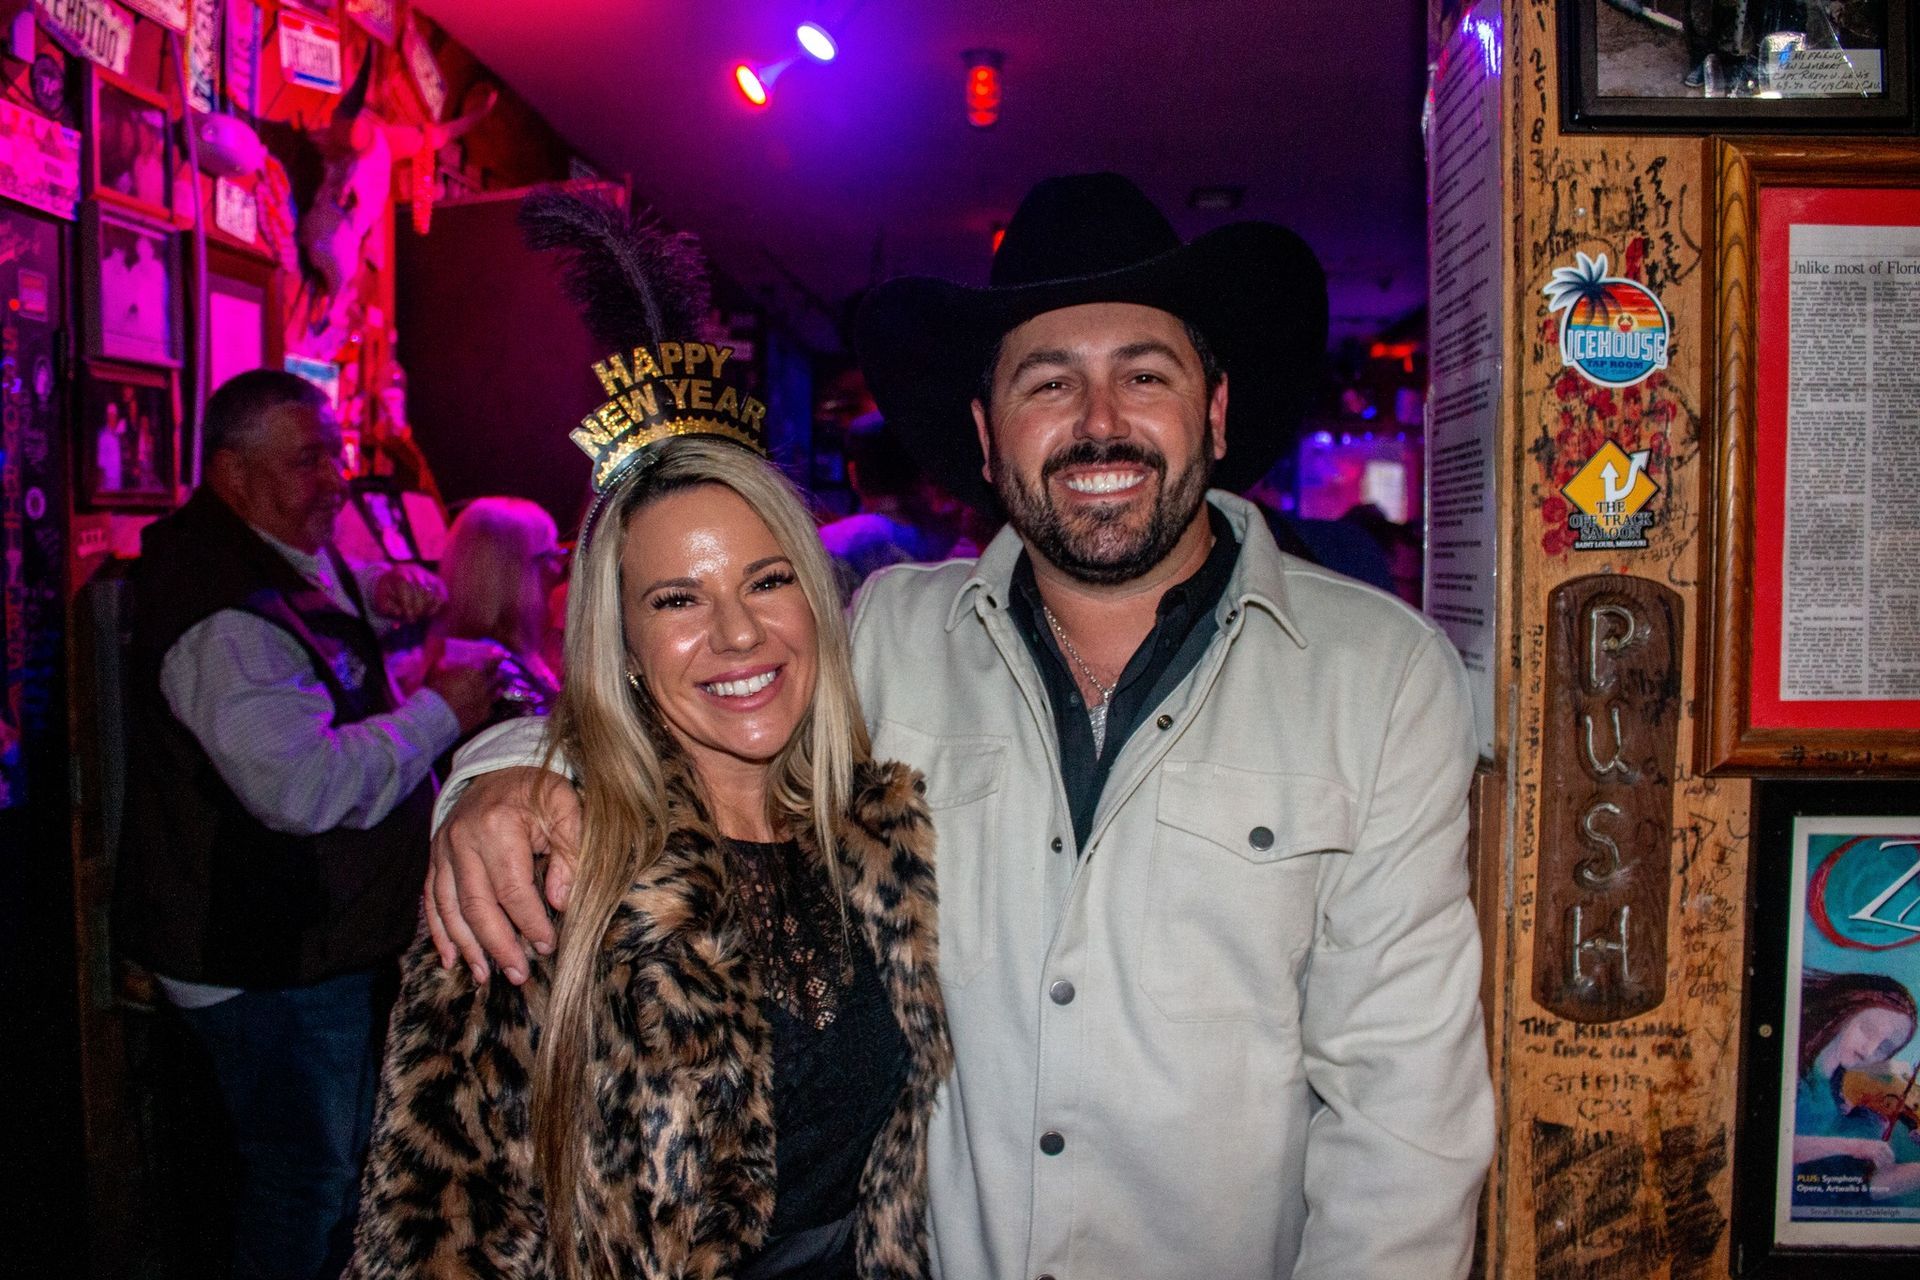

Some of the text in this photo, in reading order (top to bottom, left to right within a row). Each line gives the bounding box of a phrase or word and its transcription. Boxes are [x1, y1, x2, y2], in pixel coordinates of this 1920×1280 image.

[1789, 261, 1829, 274] Unlike
[1834, 263, 1864, 274] most
[1869, 261, 1884, 274] of
[1566, 329, 1666, 366] ICEHOUSE
[591, 341, 733, 397] HAPPY
[1587, 360, 1644, 369] TAP ROOM
[569, 377, 768, 458] NEW YEAR
[1596, 501, 1626, 514] THE
[1602, 512, 1653, 527] TRACK
[1580, 526, 1642, 541] SALOON
[1572, 604, 1637, 987] PUSH
[1797, 1184, 1824, 1193] Opera,
[1861, 1185, 1868, 1193] &
[1865, 1208, 1900, 1218] Oakleigh
